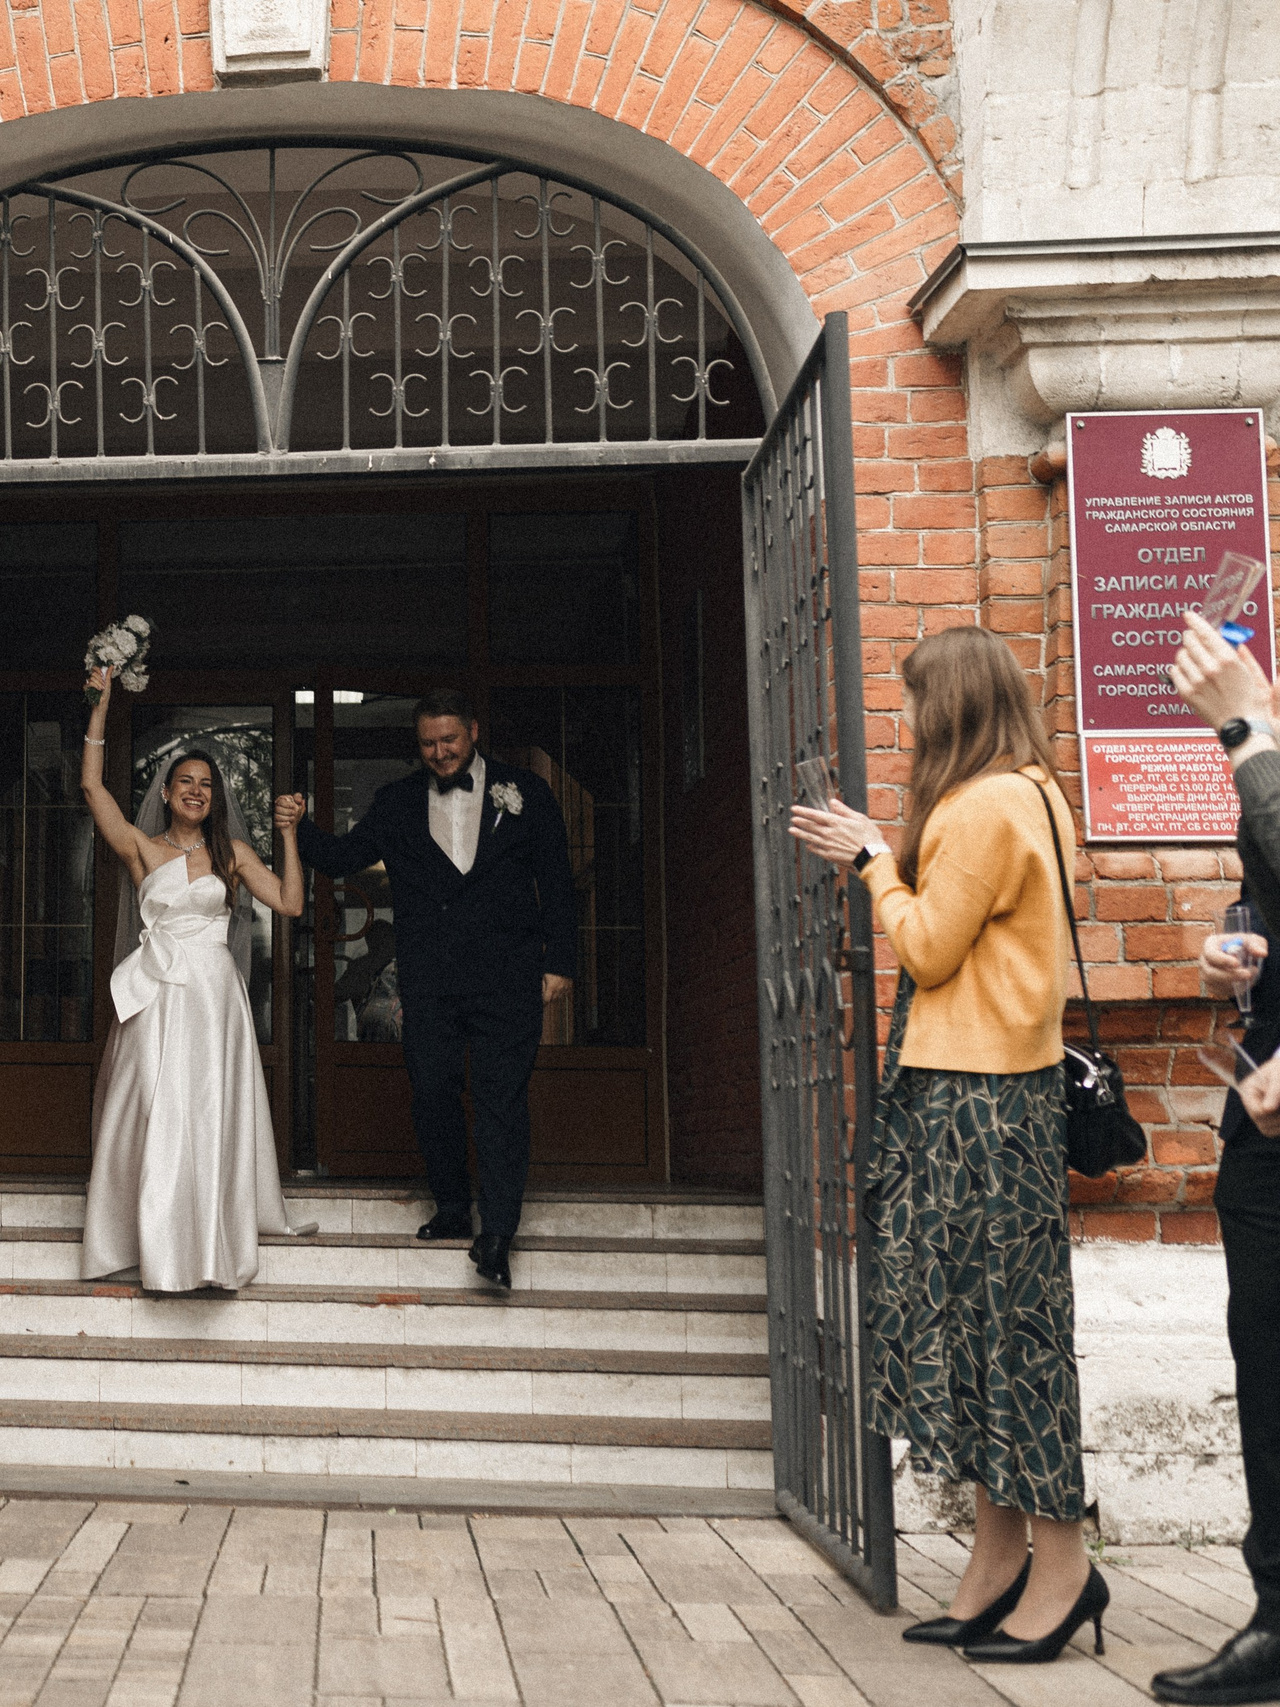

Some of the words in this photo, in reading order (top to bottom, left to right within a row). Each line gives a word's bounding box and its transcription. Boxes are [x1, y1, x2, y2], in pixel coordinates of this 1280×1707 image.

[1085, 496, 1162, 508] УПРАВЛЕНИЕ
[1164, 495, 1212, 506] ЗАПИСИ
[1214, 494, 1254, 504] АКТОВ
[1085, 509, 1179, 521] ГРАЖДАНСКОГО
[1182, 507, 1255, 518] СОСТОЯНИЯ
[1105, 521, 1178, 533] САМАРСКОЙ
[1180, 520, 1236, 532] ОБЛАСТИ
[1137, 547, 1206, 565] ОТДЕЛ
[1093, 575, 1178, 592] ЗАПИСИ
[1111, 630, 1183, 647] СОСТО
[1093, 664, 1175, 676] САМАРСКО
[1098, 684, 1178, 697] ГОРОДСКО
[1147, 703, 1195, 715] САМА
[1092, 744, 1126, 754] ОТДЕЛ
[1128, 744, 1154, 753] ЗАГС
[1155, 743, 1224, 753] САМАРСКОГО
[1105, 754, 1172, 764] ГОРОДСКОГО
[1174, 753, 1213, 762] ОКРУГА
[1140, 764, 1178, 773] РЕЖИМ
[1179, 763, 1223, 772] РАБОТЫ
[1165, 773, 1180, 782] СБ
[1181, 773, 1189, 782] С
[1211, 773, 1227, 783] ДО
[1119, 783, 1168, 792] ПЕРЕРЫВ
[1169, 783, 1177, 792] С
[1205, 783, 1220, 793] ДО
[1127, 793, 1185, 802] ВЫХОДНЫЕ
[1187, 793, 1208, 802] ДНИ
[1111, 803, 1155, 812] ЧЕТВЕРГ
[1157, 801, 1228, 812] НЕПРИЕМНЫЙ
[1128, 812, 1200, 822] РЕГИСТРАЦИЯ
[1187, 822, 1201, 831] СБ
[1202, 822, 1211, 831] С
